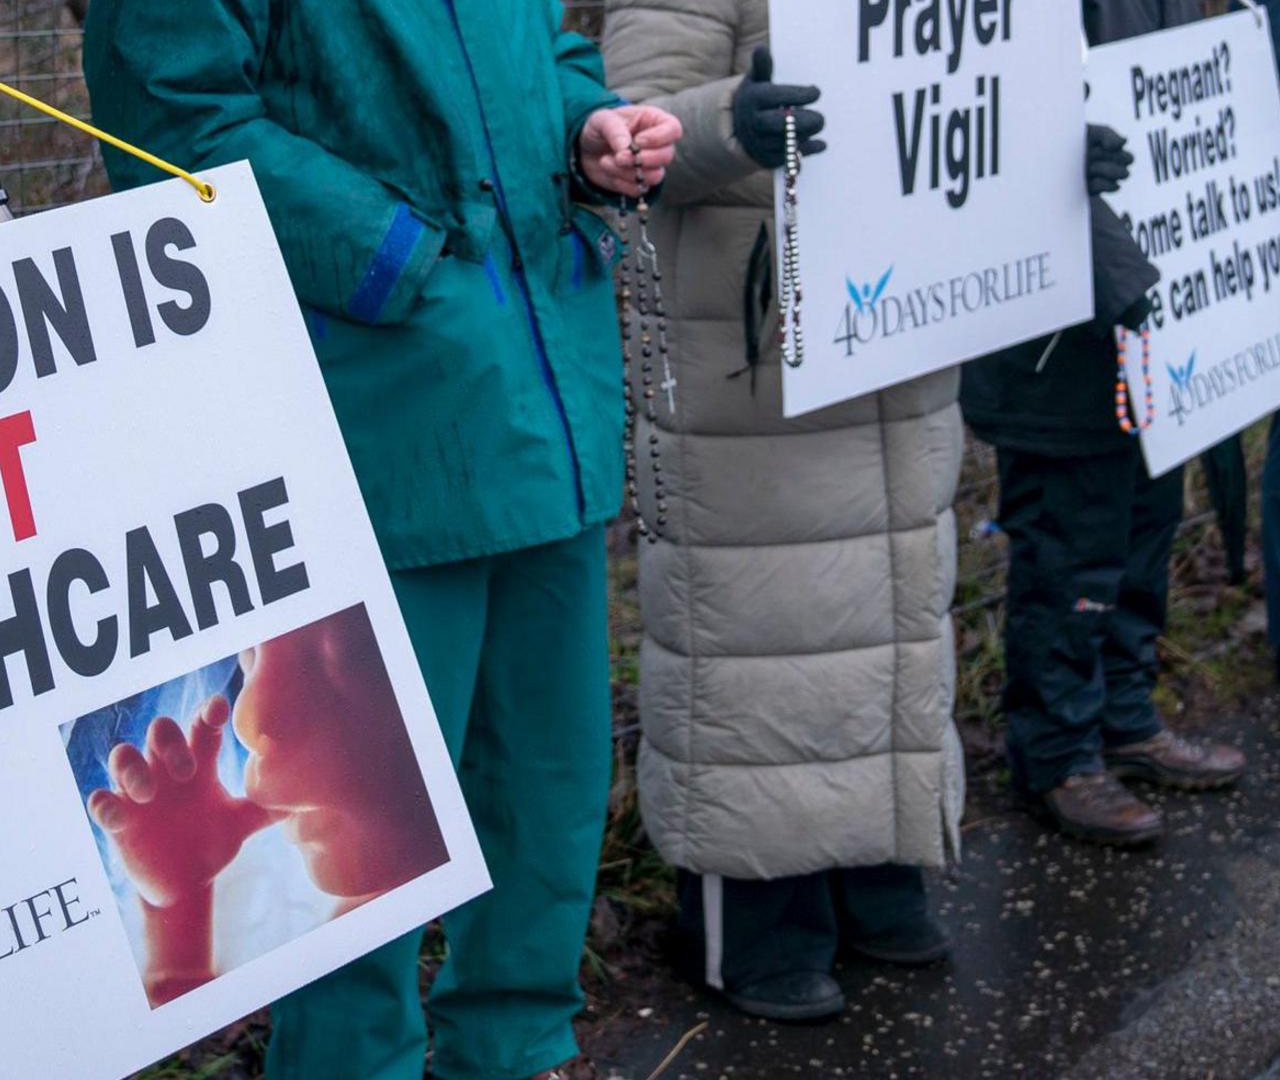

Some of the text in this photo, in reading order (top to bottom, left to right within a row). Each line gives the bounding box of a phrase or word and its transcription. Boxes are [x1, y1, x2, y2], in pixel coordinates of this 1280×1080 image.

[1130, 40, 1232, 121] Pregnant?
[892, 75, 1000, 209] Vigil
[1147, 104, 1237, 185] Worried?
[1186, 181, 1228, 242] talk
[1228, 174, 1251, 221] to
[111, 215, 212, 348] IS
[833, 251, 1057, 356] 40 DAYS FOR LIFE
[1169, 267, 1210, 322] can
[1209, 239, 1255, 302] help
[1192, 357, 1236, 408] DAYS
[1233, 341, 1267, 386] FOR
